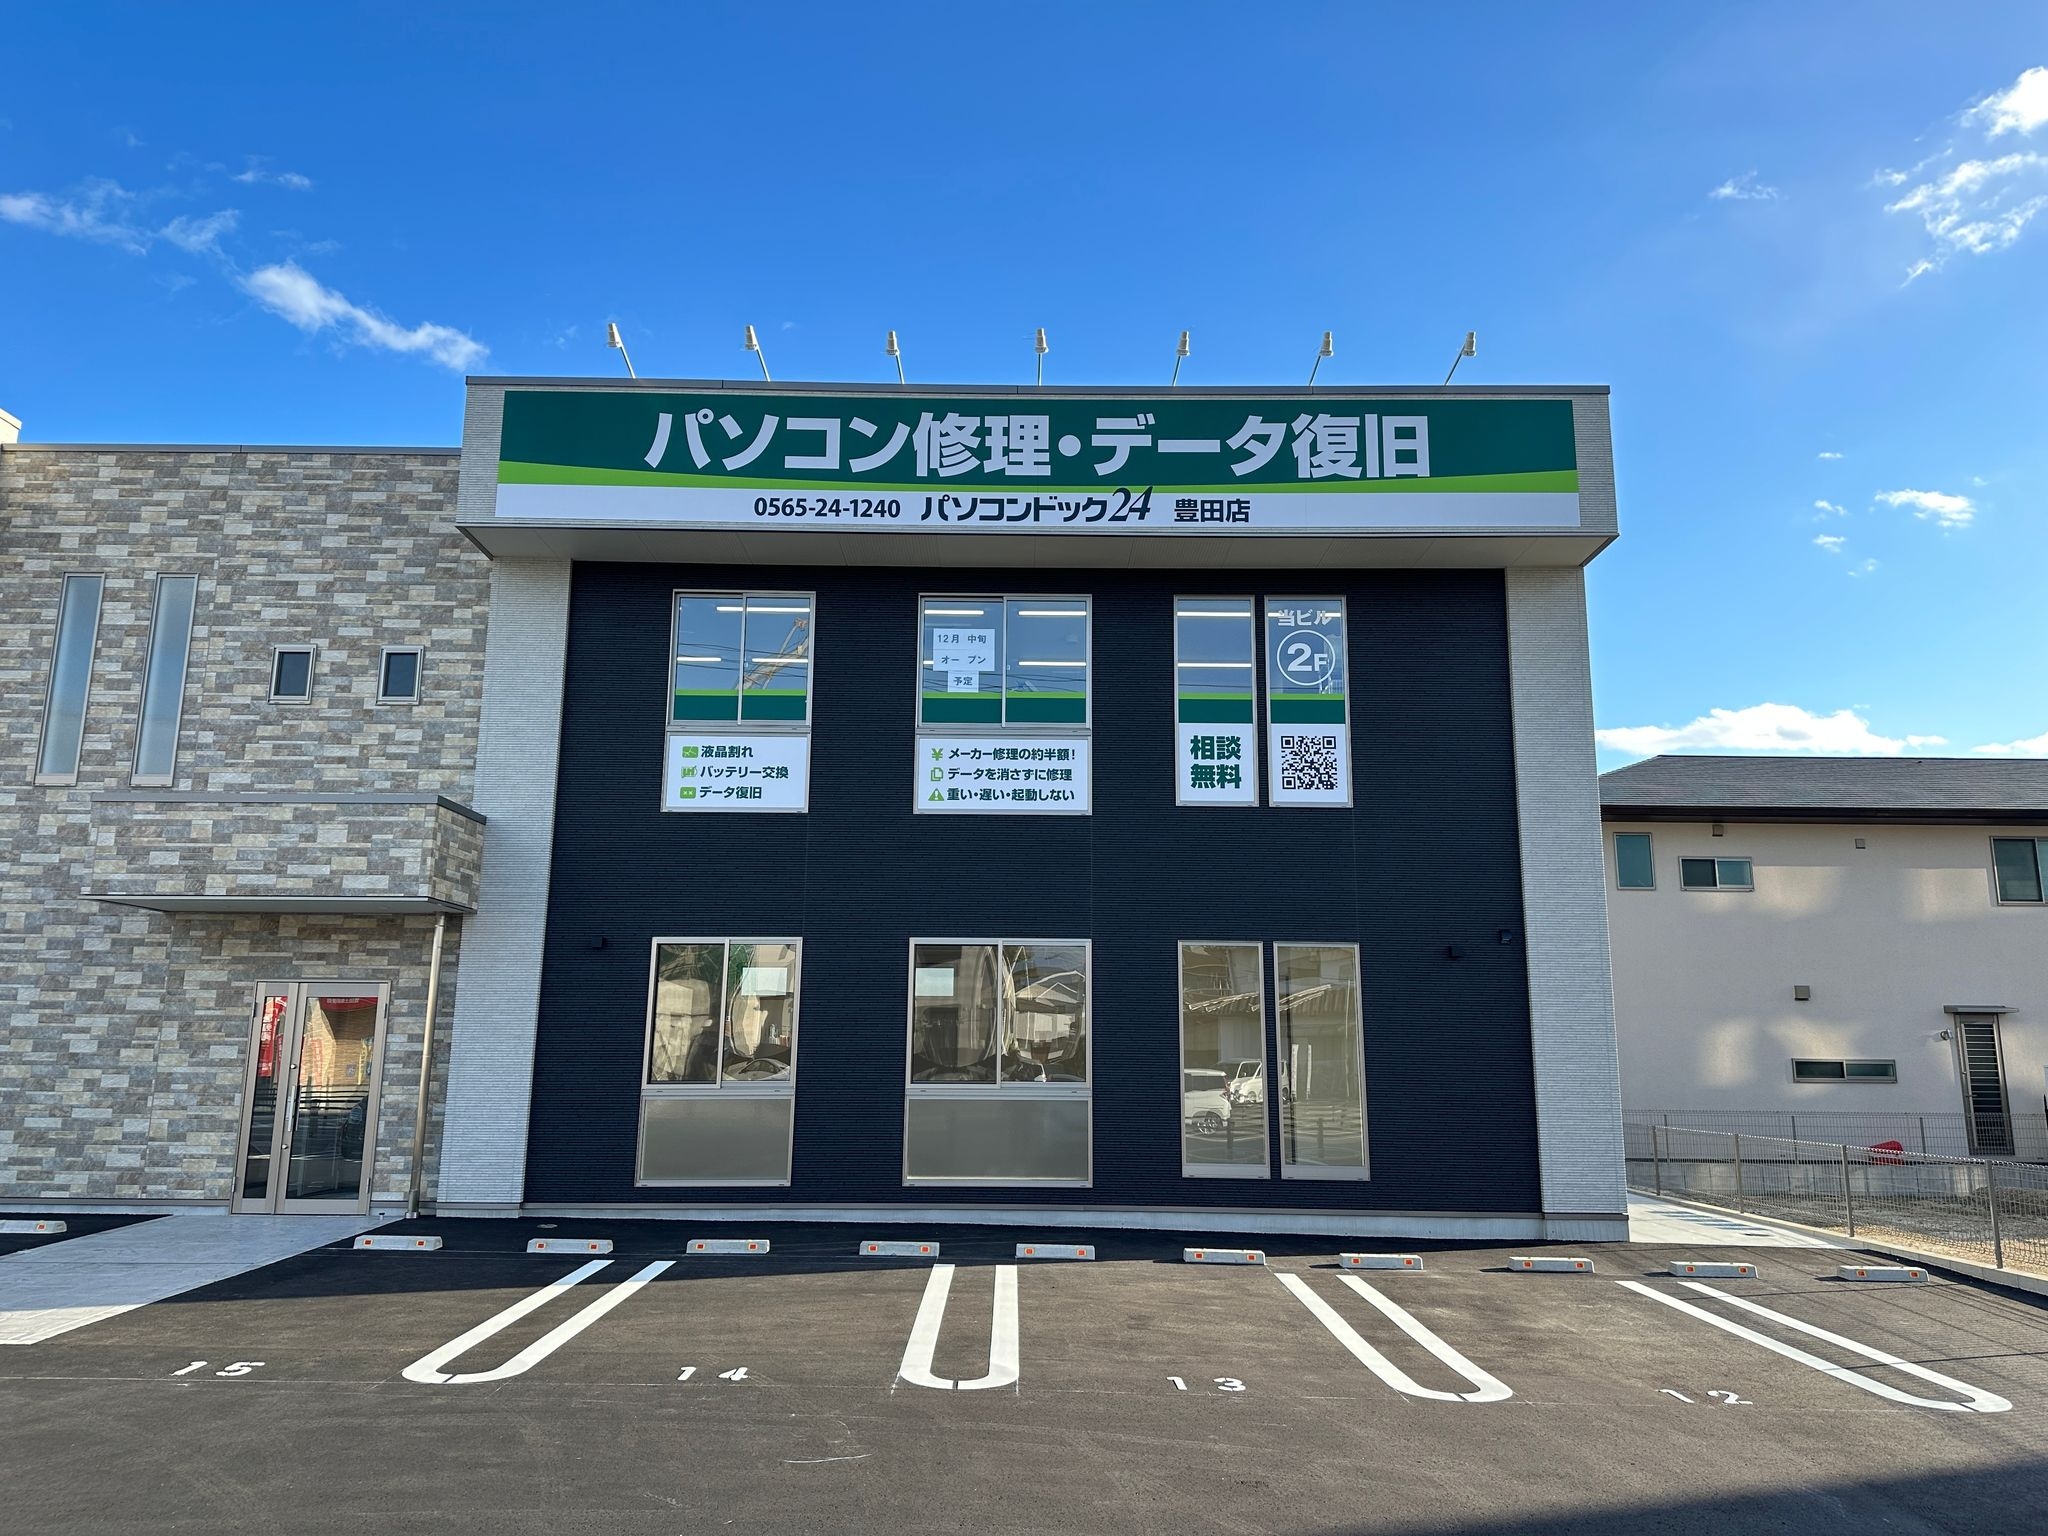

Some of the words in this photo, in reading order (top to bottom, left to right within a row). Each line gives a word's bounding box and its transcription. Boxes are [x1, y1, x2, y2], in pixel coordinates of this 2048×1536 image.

[644, 408, 1430, 478] パソコン修理・データ復旧
[754, 497, 901, 518] 0565-24-1240
[1174, 498, 1251, 523] 豊田店
[1278, 609, 1332, 627] 当ビル
[1287, 642, 1328, 672] 2F
[952, 676, 973, 686] 予定
[701, 745, 754, 758] 液晶割れ
[1190, 735, 1242, 760] 相談
[700, 766, 789, 779] バッテリー交換
[947, 767, 1073, 781] データを消さずに修理
[1190, 764, 1242, 789] 無料
[699, 786, 762, 799] データ復旧
[946, 788, 1075, 802] 重い・遅い・起動しない
